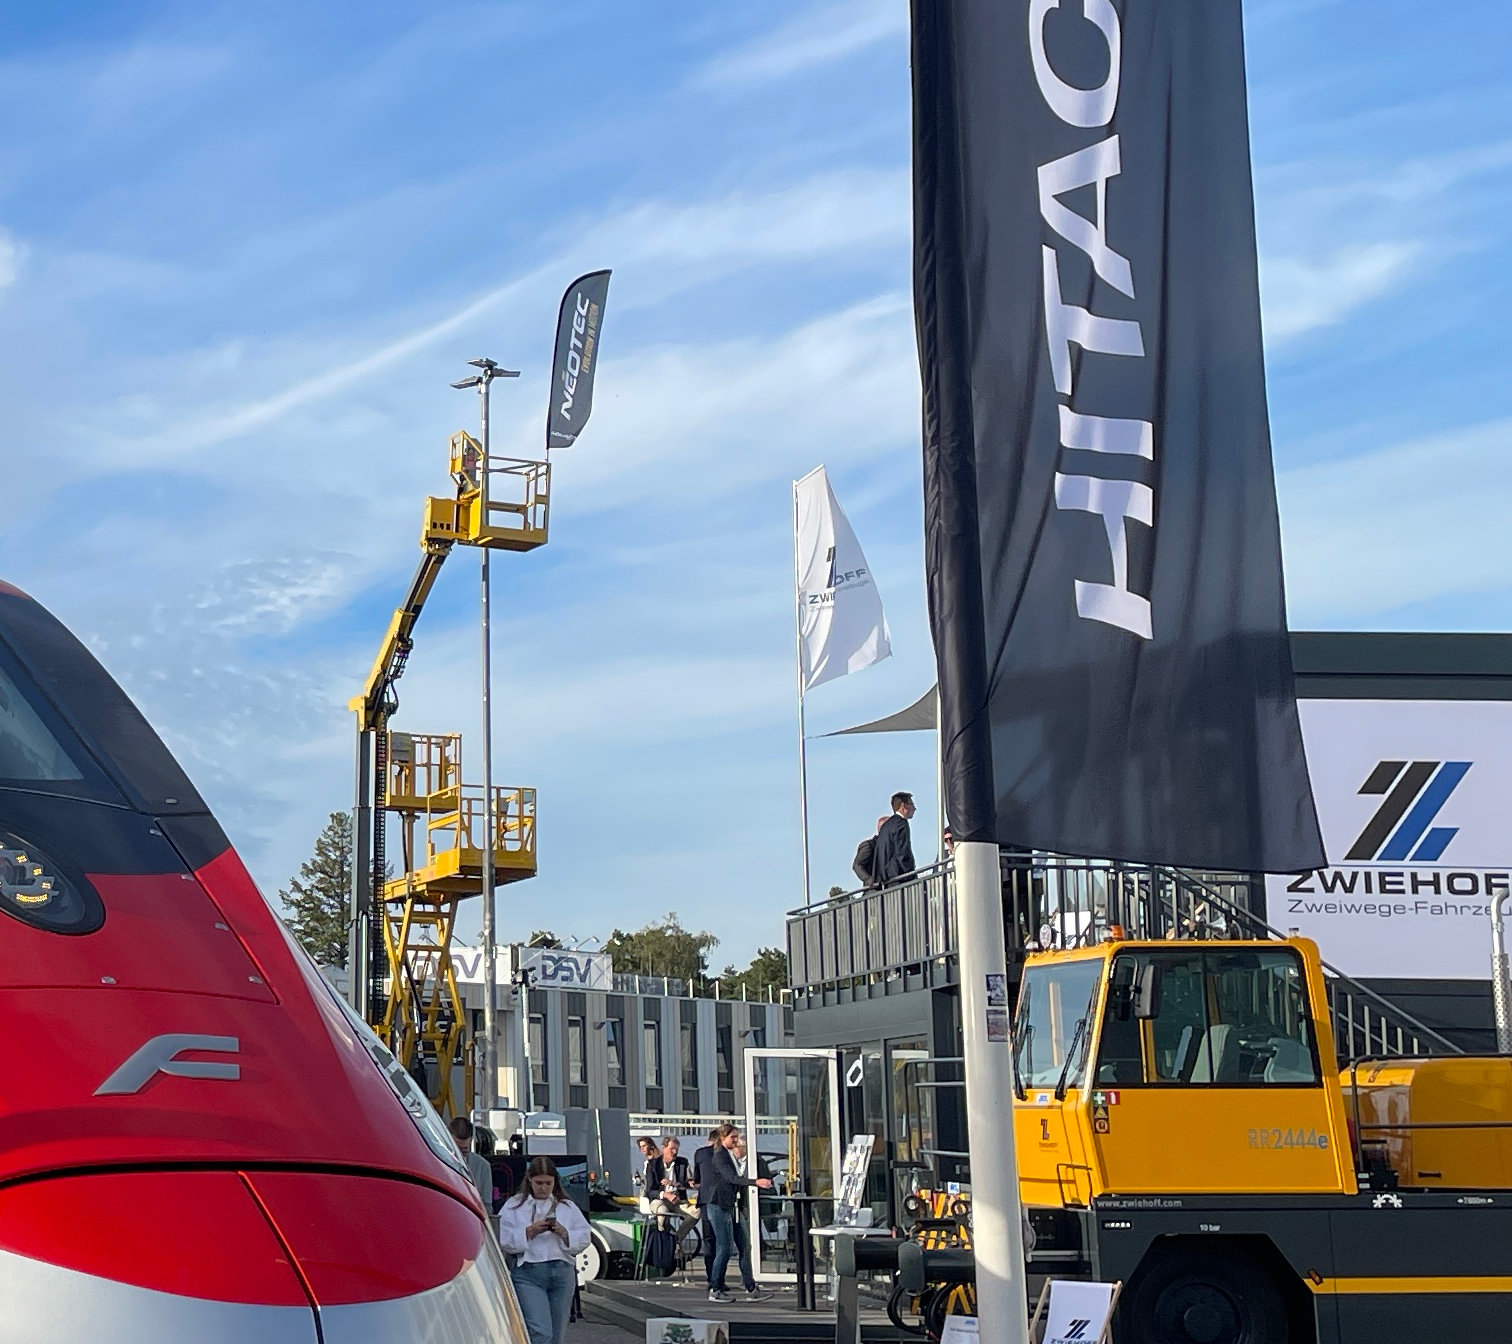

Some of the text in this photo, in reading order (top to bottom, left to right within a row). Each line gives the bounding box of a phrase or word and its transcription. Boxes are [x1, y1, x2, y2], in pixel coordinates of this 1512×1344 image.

[541, 954, 593, 984] DSV
[1248, 1128, 1329, 1150] RR2444e
[1097, 1198, 1183, 1208] www.zwiehoff.com
